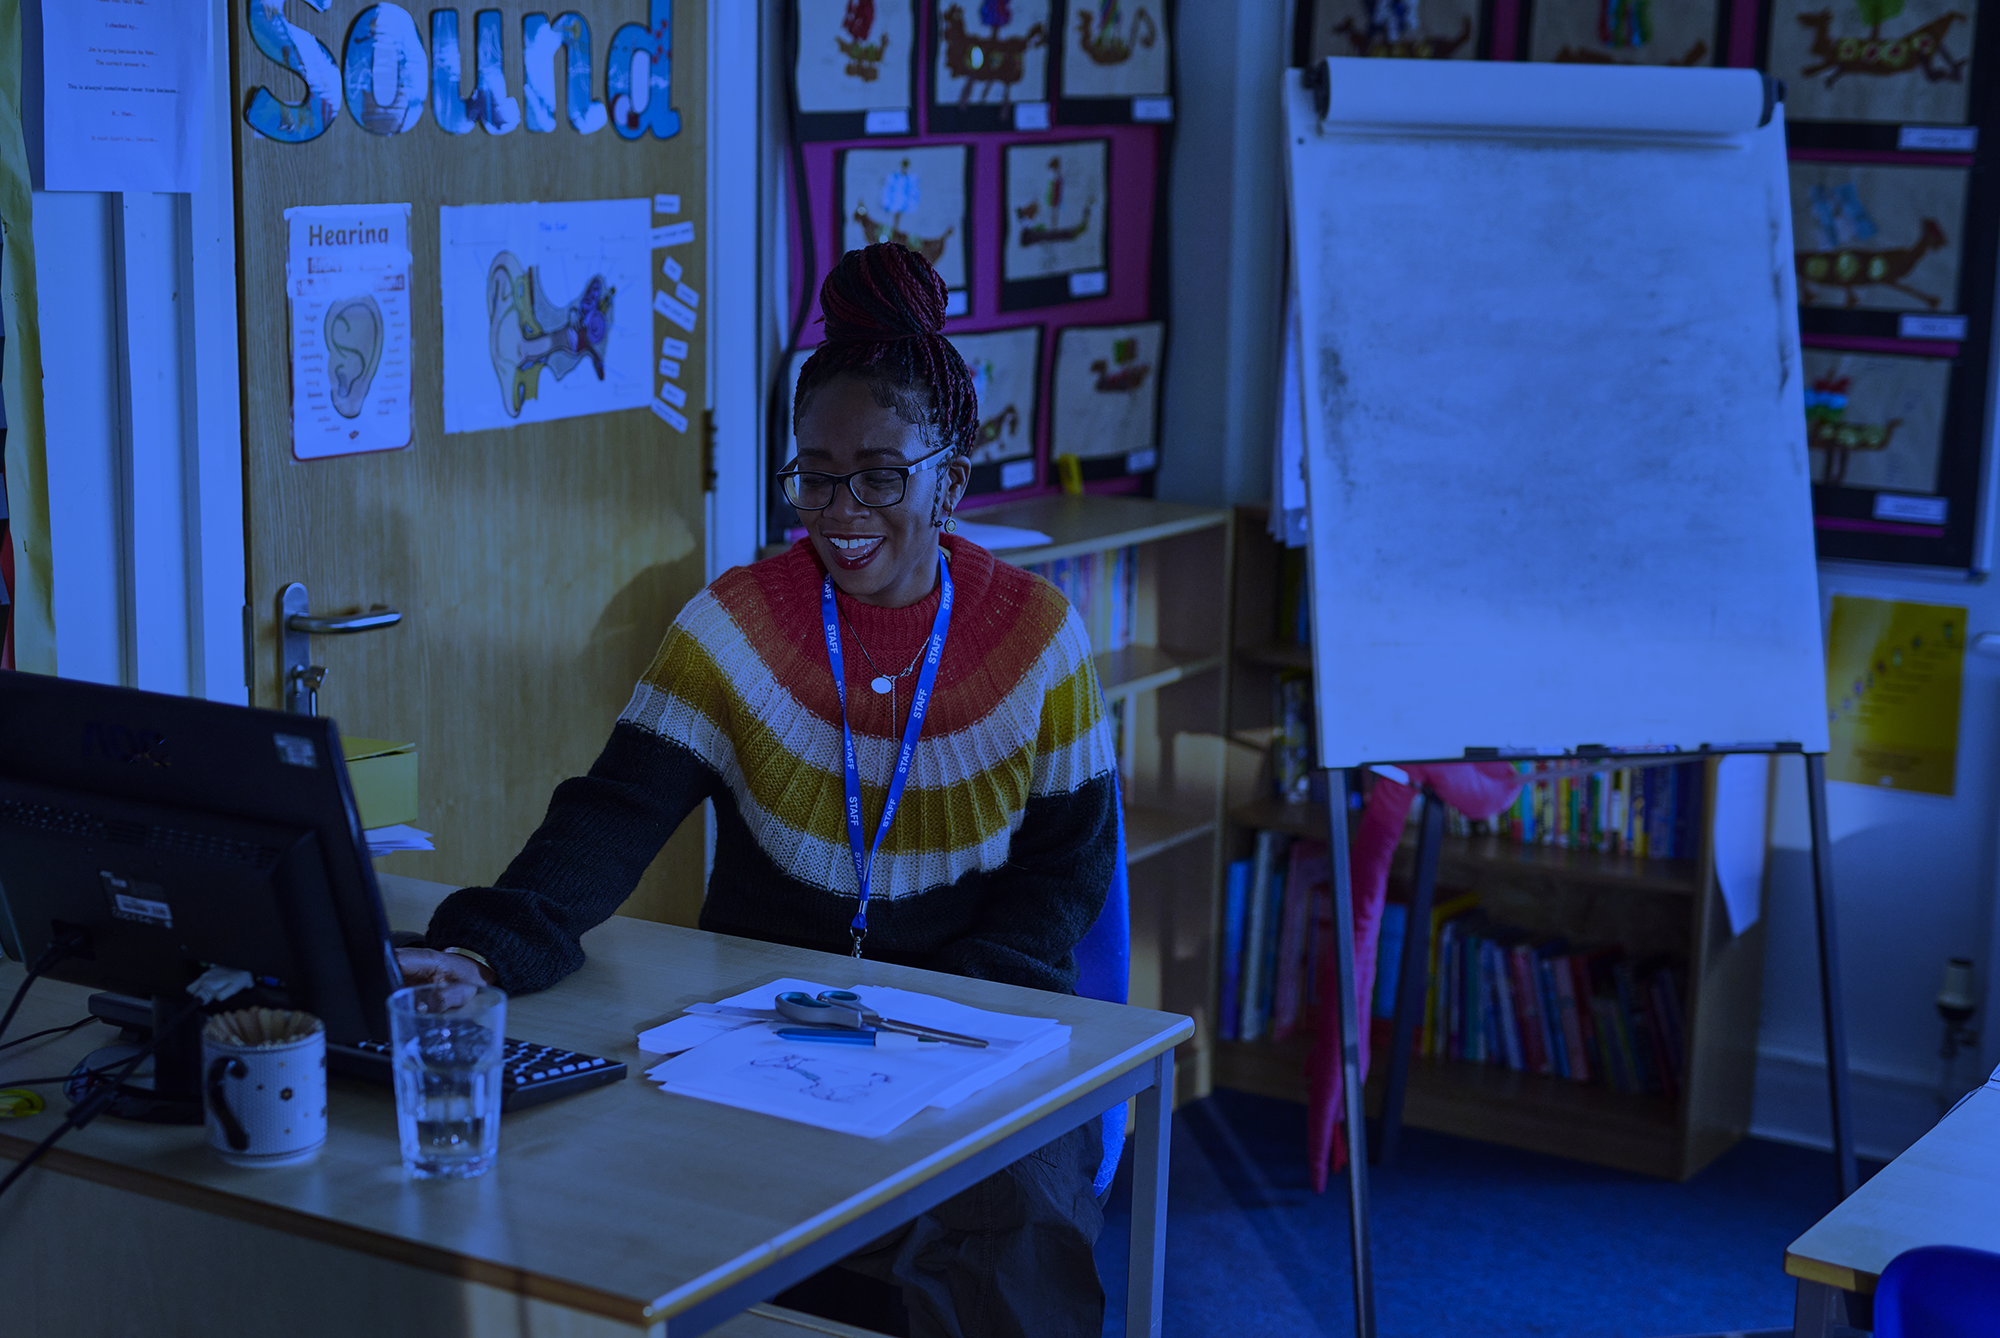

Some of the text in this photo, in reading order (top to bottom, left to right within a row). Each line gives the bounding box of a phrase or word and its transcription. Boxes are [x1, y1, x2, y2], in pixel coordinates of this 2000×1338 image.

[245, 0, 683, 143] Sound
[827, 624, 838, 654] STAFF
[883, 581, 952, 827] STAFF STAFF STAFF STAFF STAFF
[846, 740, 854, 770] STAFF
[849, 796, 859, 826] STAFF
